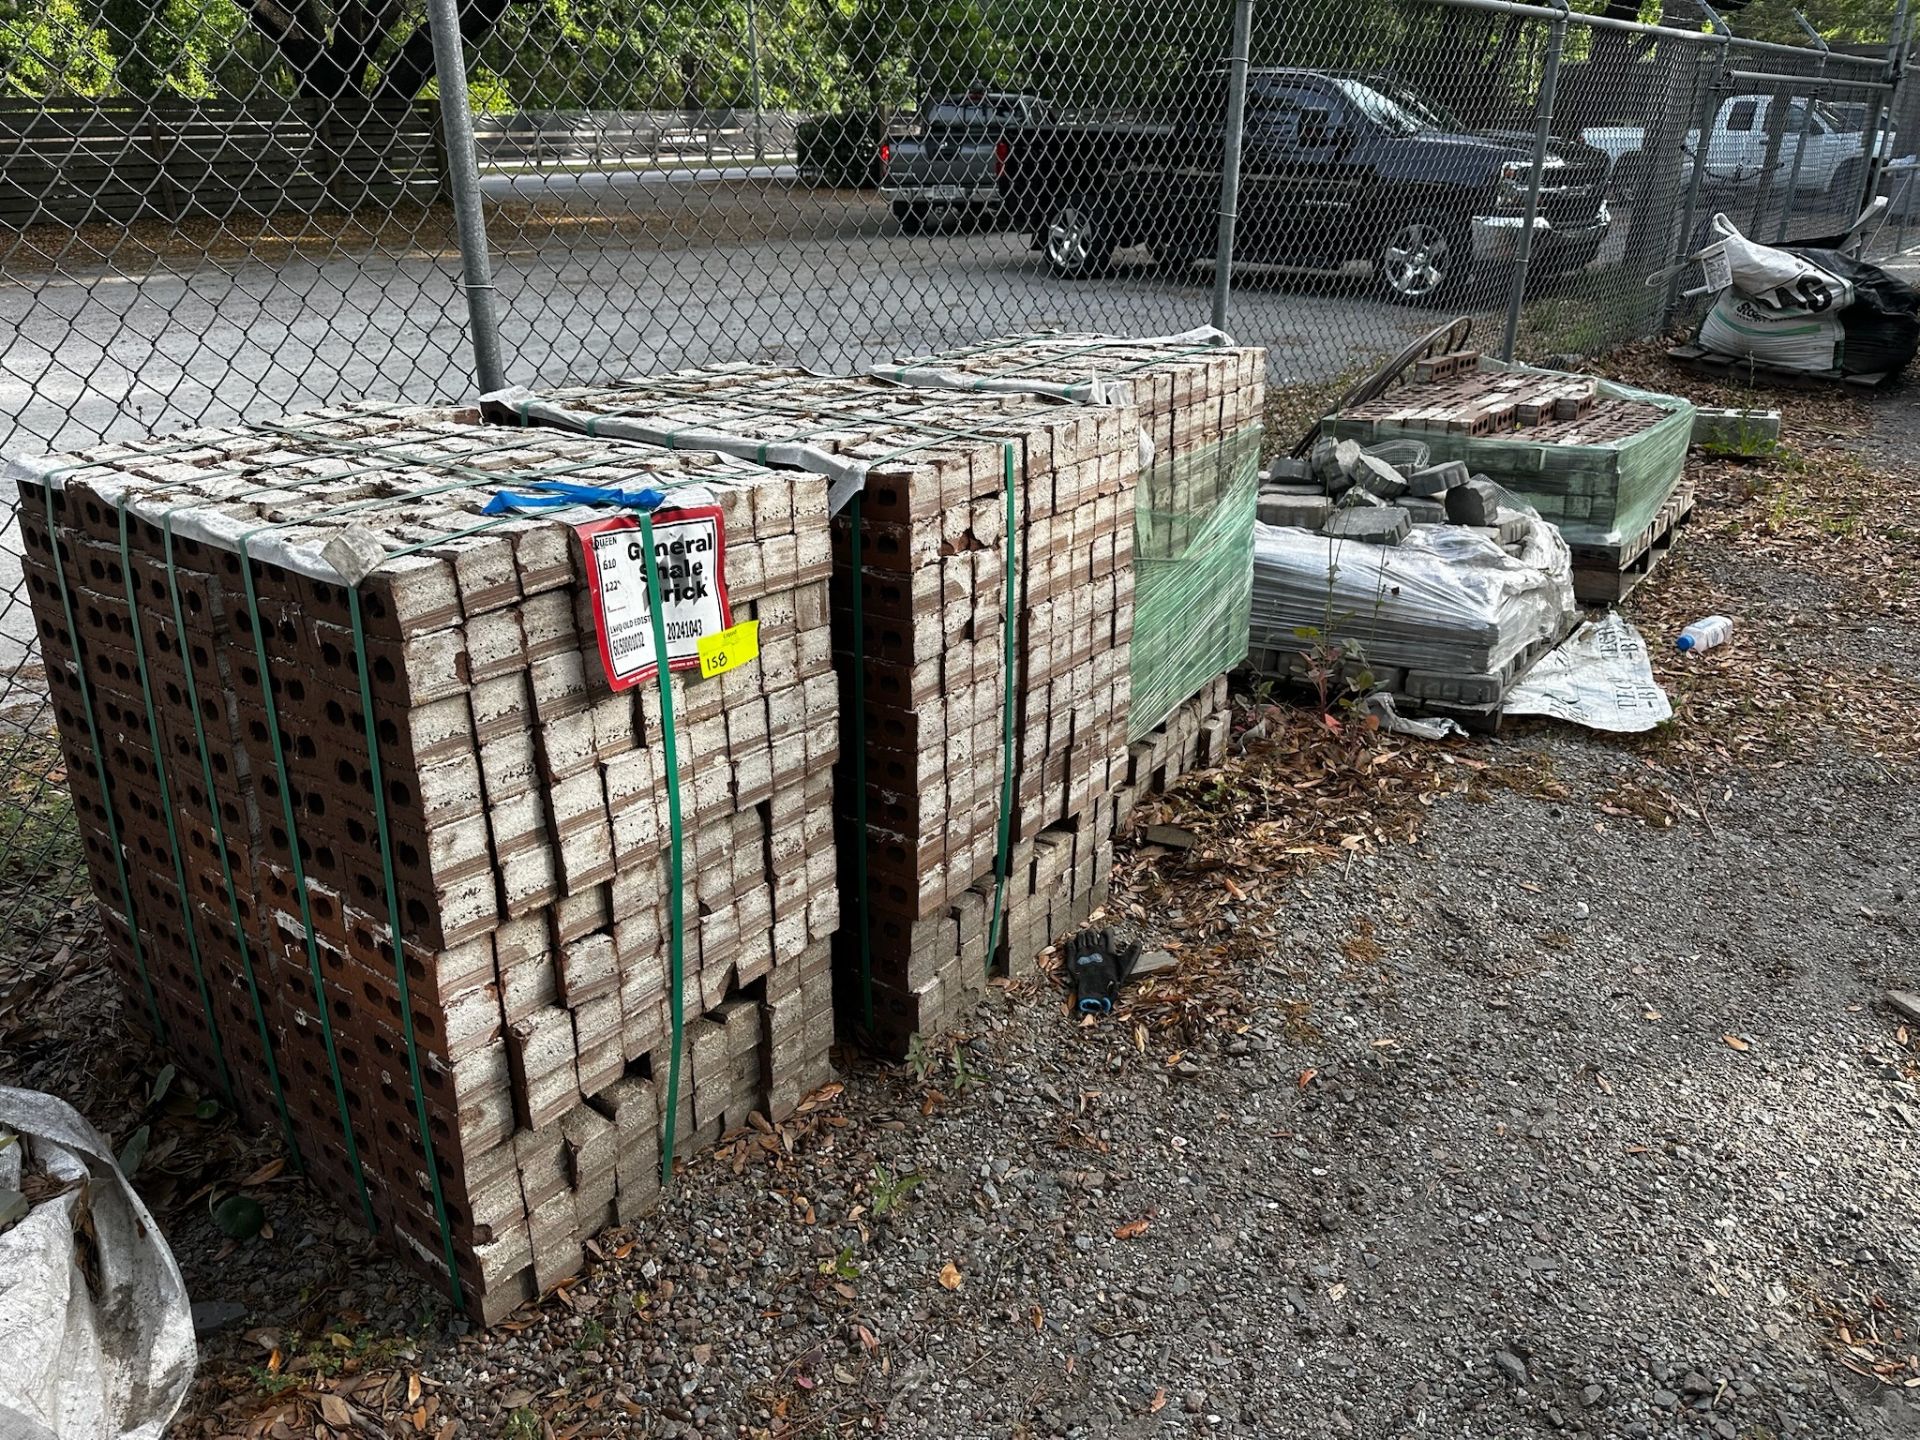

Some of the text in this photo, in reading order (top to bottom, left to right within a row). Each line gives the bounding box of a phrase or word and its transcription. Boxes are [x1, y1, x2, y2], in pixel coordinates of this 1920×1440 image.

[595, 537, 617, 549] QUEEN
[628, 533, 712, 560] Gneral
[603, 558, 616, 570] 610
[648, 581, 708, 605] rick
[666, 619, 703, 640] 20241043
[707, 652, 728, 671] 158
